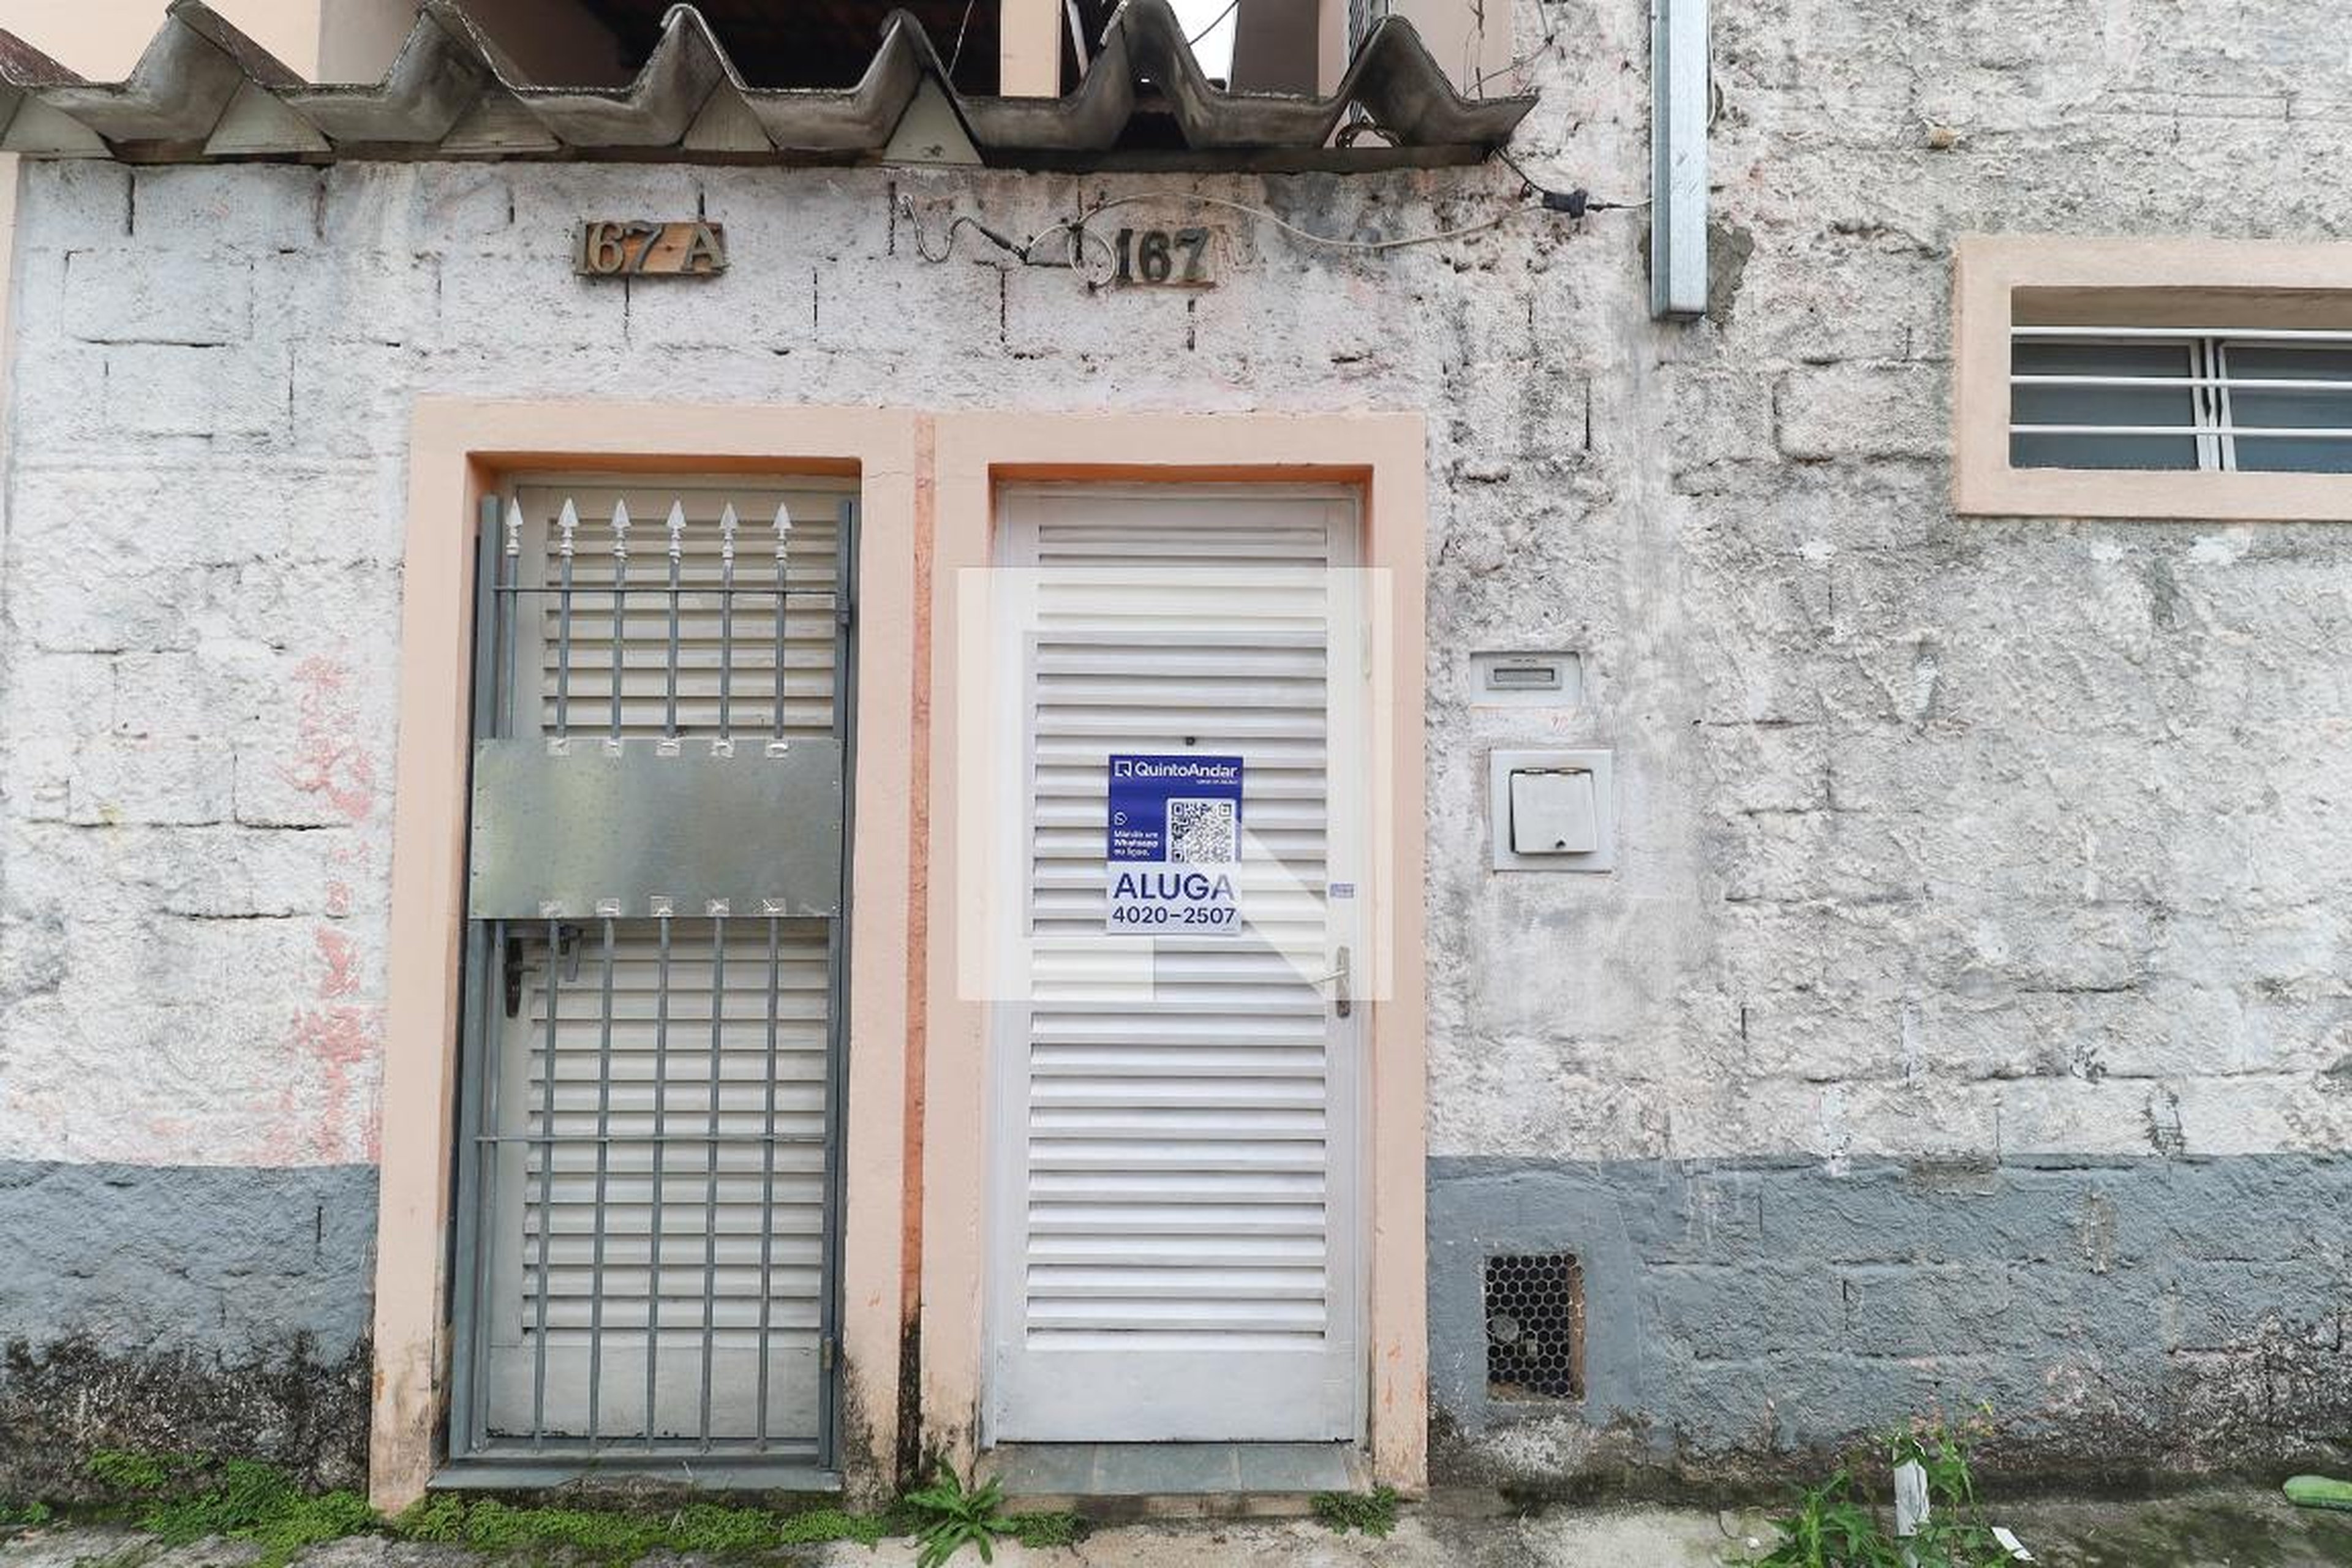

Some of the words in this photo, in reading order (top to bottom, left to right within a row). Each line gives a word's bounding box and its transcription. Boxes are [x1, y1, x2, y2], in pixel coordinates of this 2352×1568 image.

[680, 222, 729, 273] A
[1115, 228, 1210, 287] 167
[1135, 761, 1237, 777] QuintoAndar
[1113, 873, 1234, 900] ALUGA
[1112, 906, 1236, 924] 4020-2507
